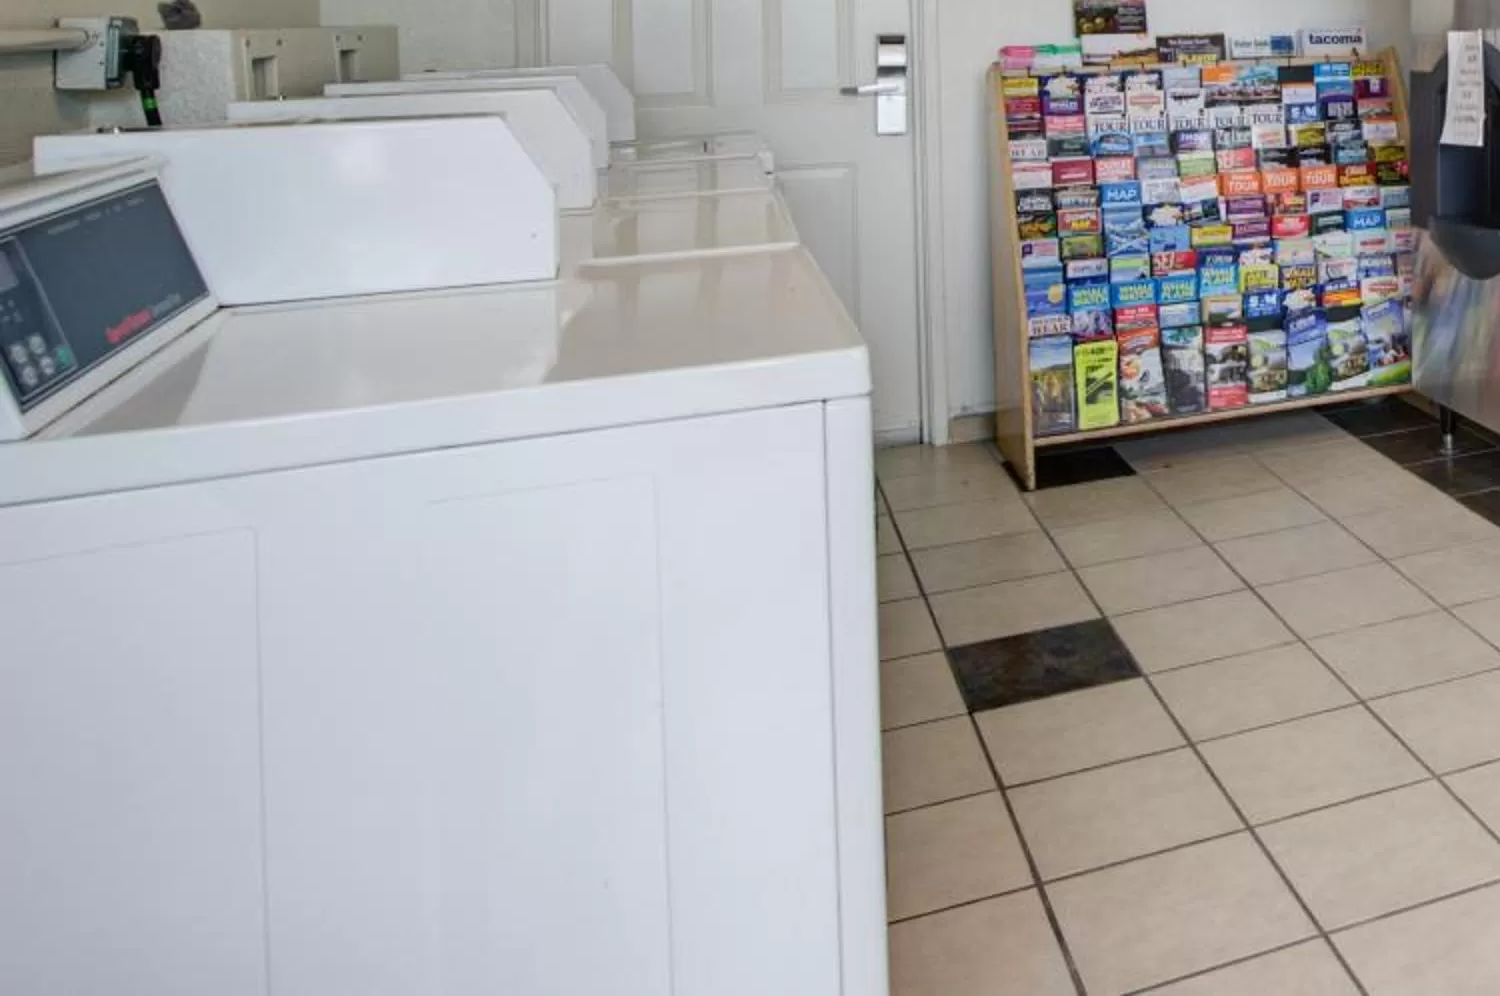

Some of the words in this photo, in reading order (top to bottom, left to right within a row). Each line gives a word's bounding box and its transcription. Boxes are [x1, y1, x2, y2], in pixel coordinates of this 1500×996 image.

[1308, 32, 1364, 46] tacoma
[1133, 117, 1165, 131] TOUR
[1252, 113, 1284, 125] TOUR
[1106, 189, 1138, 201] MAP
[1353, 214, 1381, 228] MAP
